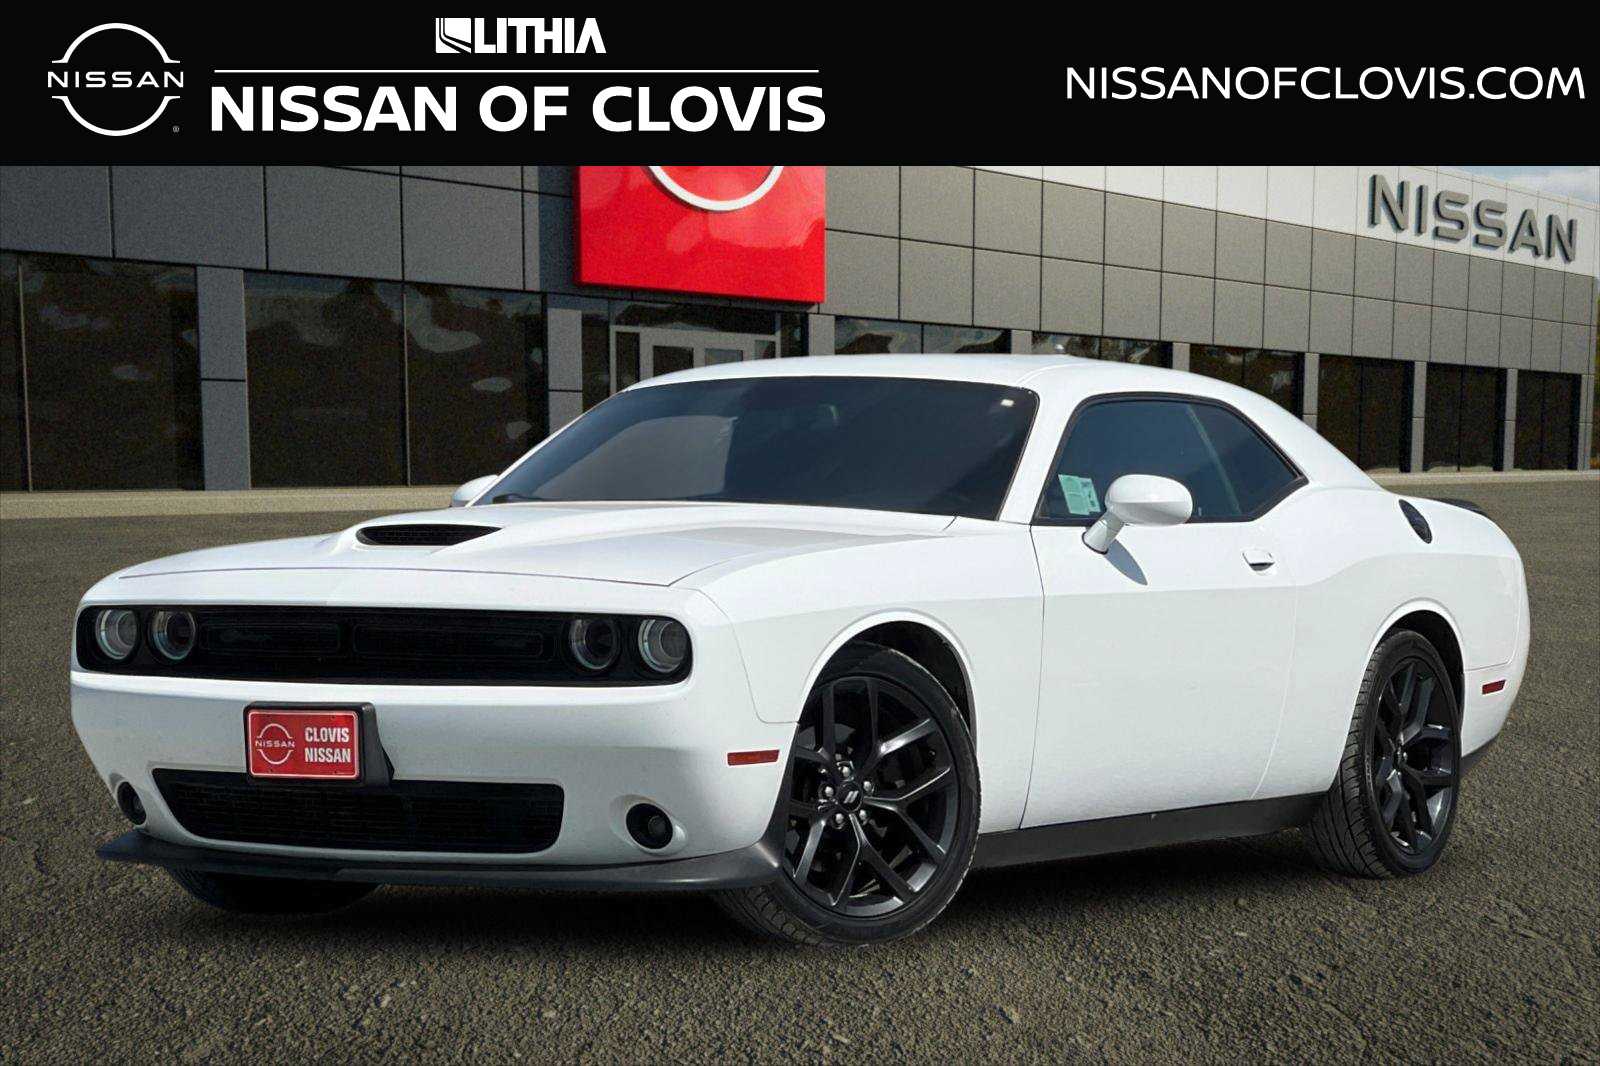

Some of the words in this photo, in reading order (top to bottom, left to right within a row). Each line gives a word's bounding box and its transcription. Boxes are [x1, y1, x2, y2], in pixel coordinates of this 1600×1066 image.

[1369, 174, 1577, 263] NISSAN
[305, 727, 349, 743] CLOVIS
[255, 740, 295, 748] NISSAN
[304, 747, 351, 763] NISSAN
